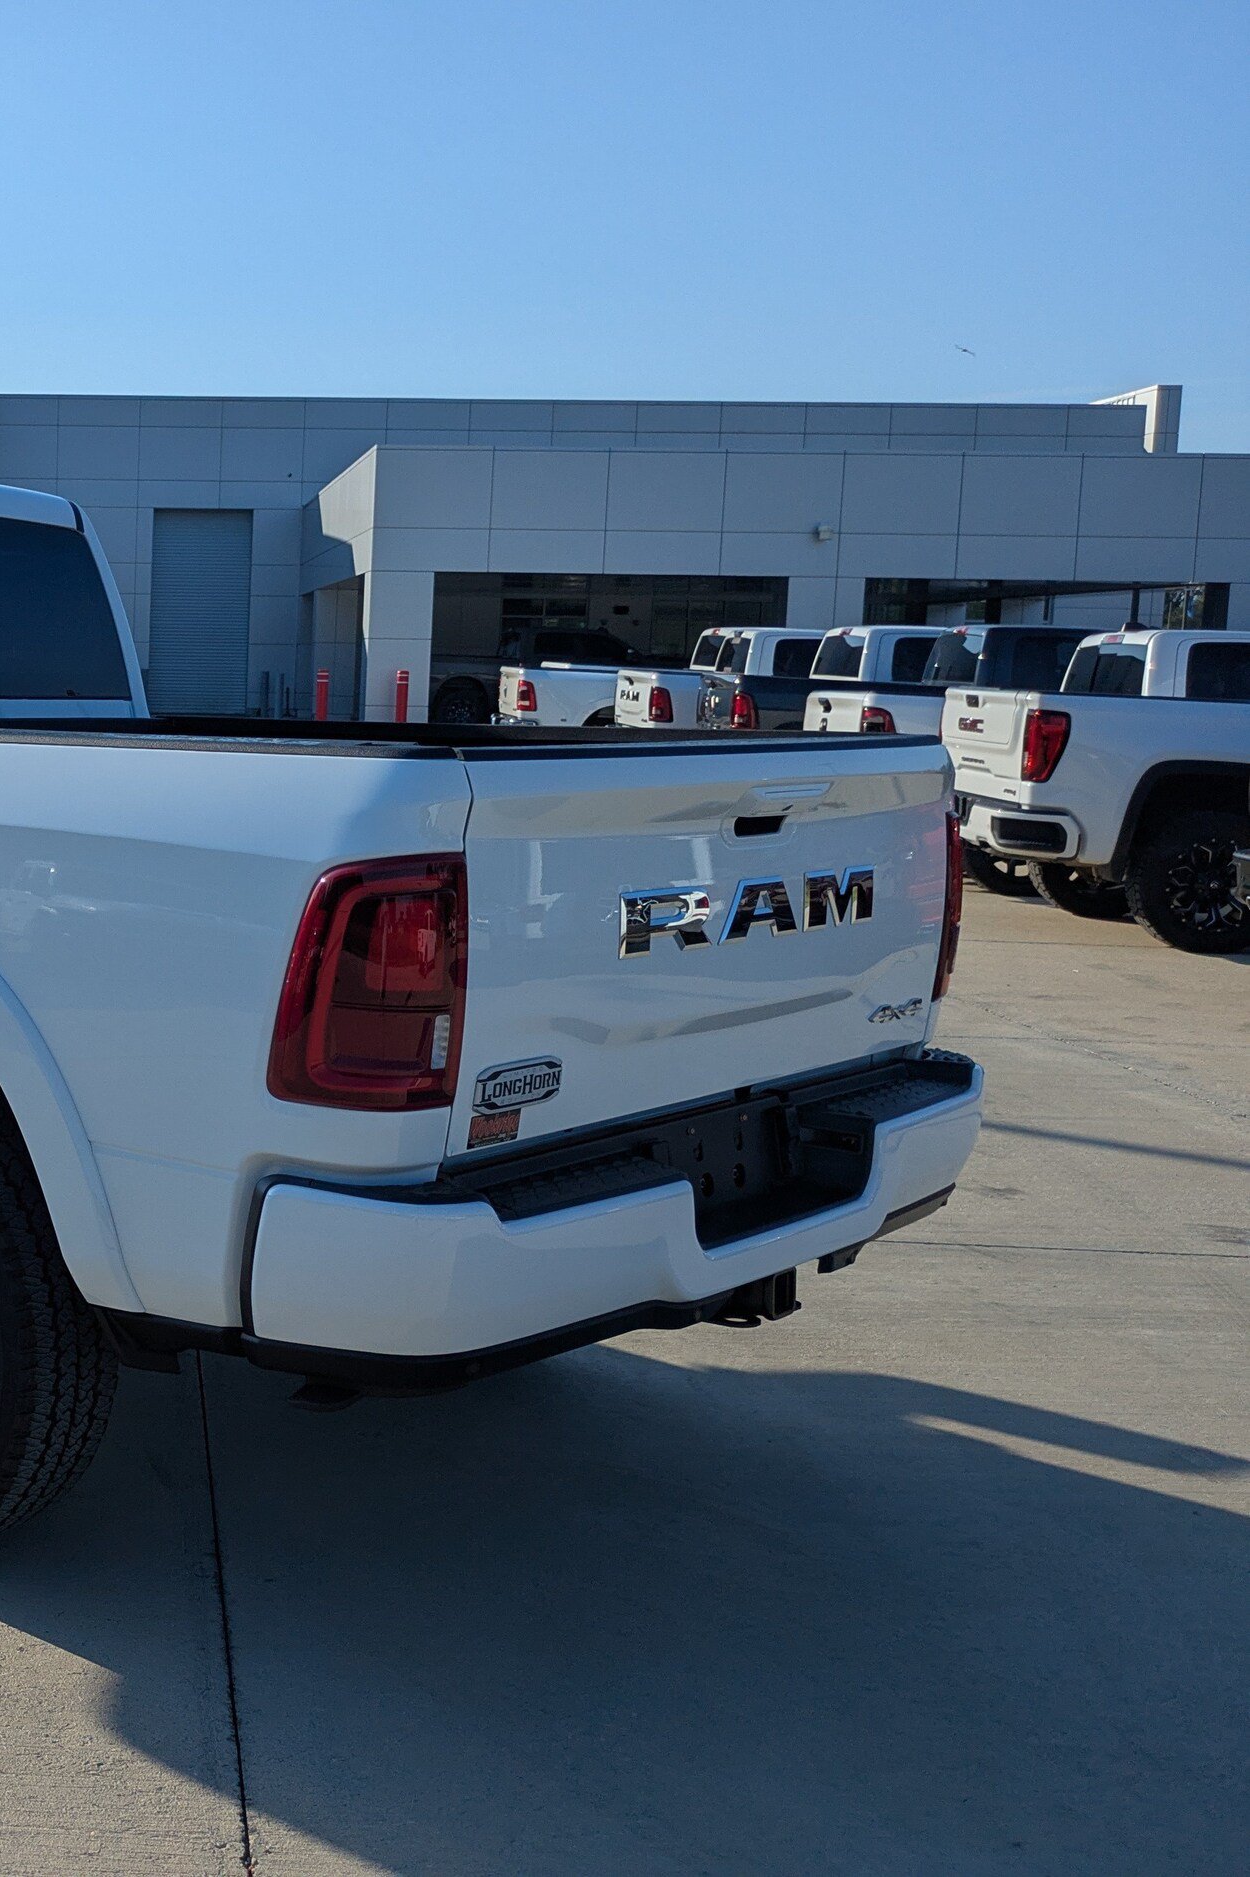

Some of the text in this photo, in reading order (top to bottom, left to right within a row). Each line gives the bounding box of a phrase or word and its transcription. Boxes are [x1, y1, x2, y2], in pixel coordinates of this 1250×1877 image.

[619, 689, 640, 702] RAM
[958, 717, 984, 733] GMC
[618, 863, 875, 960] RAM
[480, 1070, 562, 1104] LONGHORN
